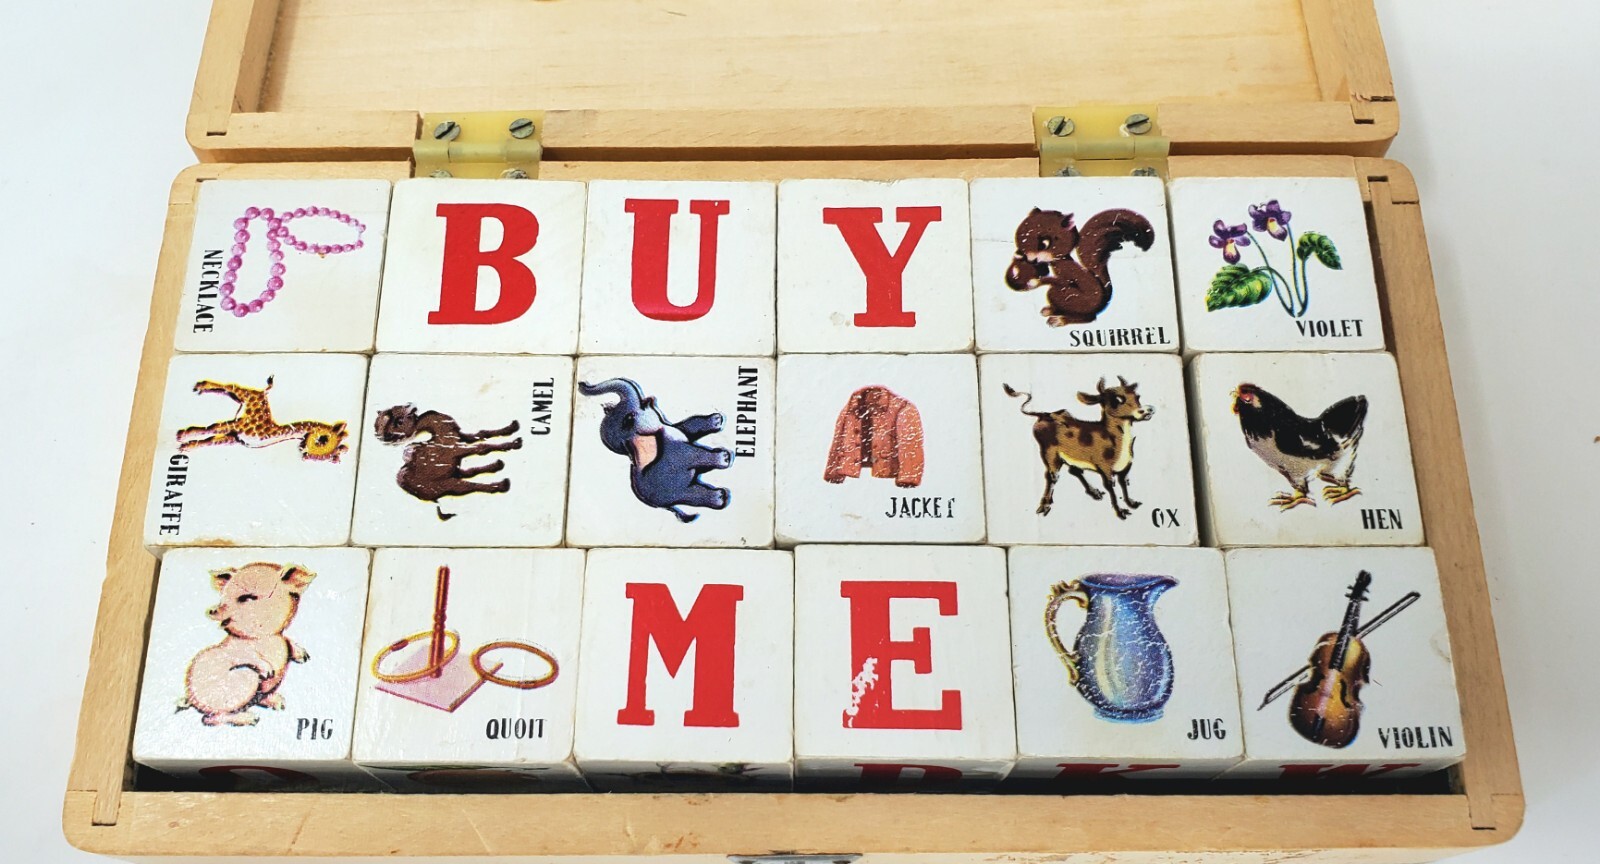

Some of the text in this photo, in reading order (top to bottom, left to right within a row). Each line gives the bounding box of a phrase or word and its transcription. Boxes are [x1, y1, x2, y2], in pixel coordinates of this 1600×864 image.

[193, 249, 224, 334] NECKLACE
[1069, 326, 1171, 347] SQUIRREL
[1295, 319, 1363, 338] VIOLET
[530, 377, 555, 436] CAMEL
[735, 365, 759, 458] ELEPHANT
[159, 454, 189, 536] GIRAFFE
[885, 497, 955, 519] JACKET
[1151, 507, 1181, 529] OX
[1361, 508, 1404, 530] HEN
[296, 717, 334, 741] PIG
[485, 717, 546, 741] QUOIT
[1186, 717, 1228, 741] JUG
[1377, 726, 1454, 750] VIOLIN
